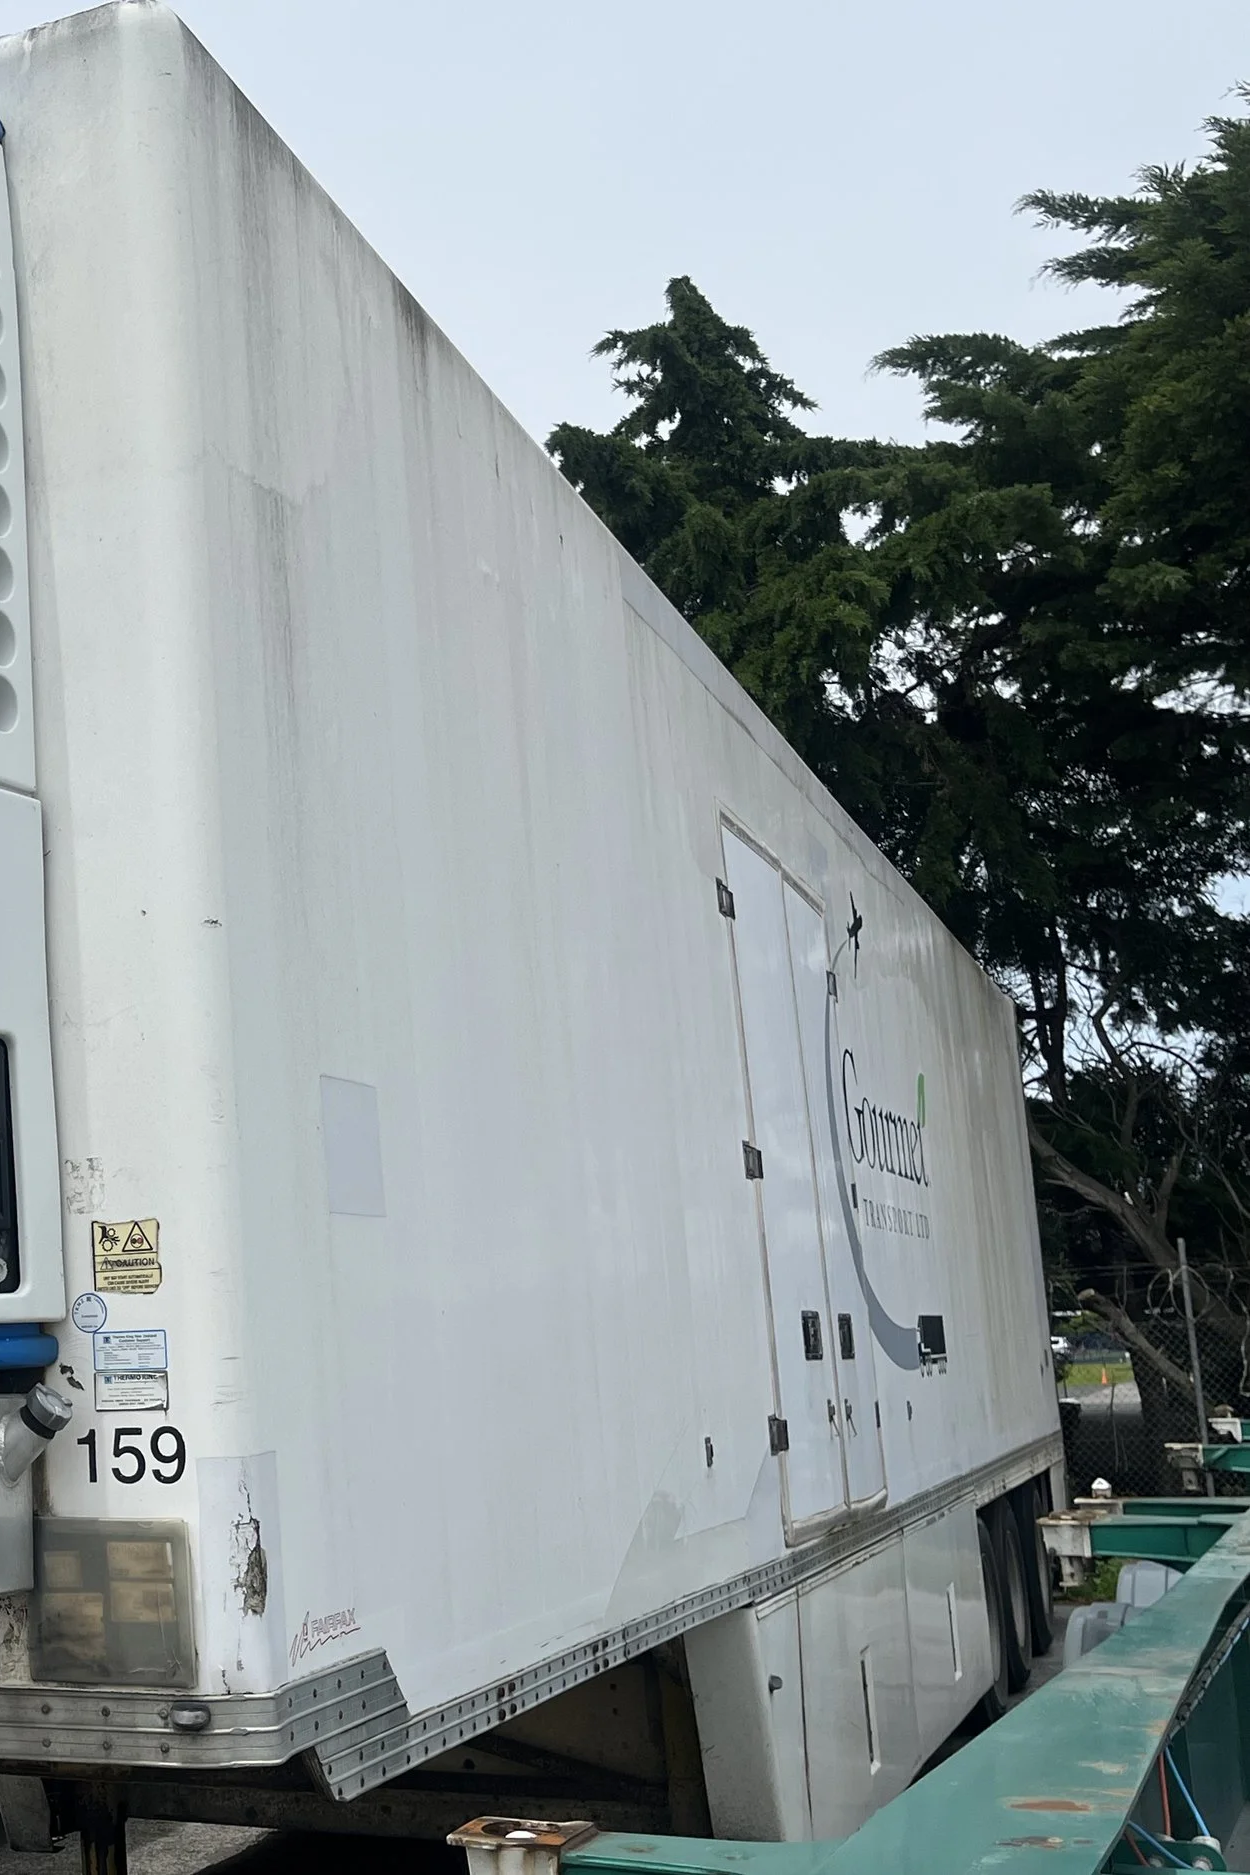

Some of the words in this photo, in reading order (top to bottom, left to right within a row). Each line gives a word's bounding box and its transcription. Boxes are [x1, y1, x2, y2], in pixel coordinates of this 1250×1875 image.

[842, 1048, 929, 1188] Gourmet
[862, 1198, 914, 1237] TRANSPORT
[915, 1213, 931, 1240] LTD
[115, 1258, 155, 1267] CAUTION
[77, 1425, 187, 1484] 159
[311, 1608, 357, 1638] FAIRFAX
